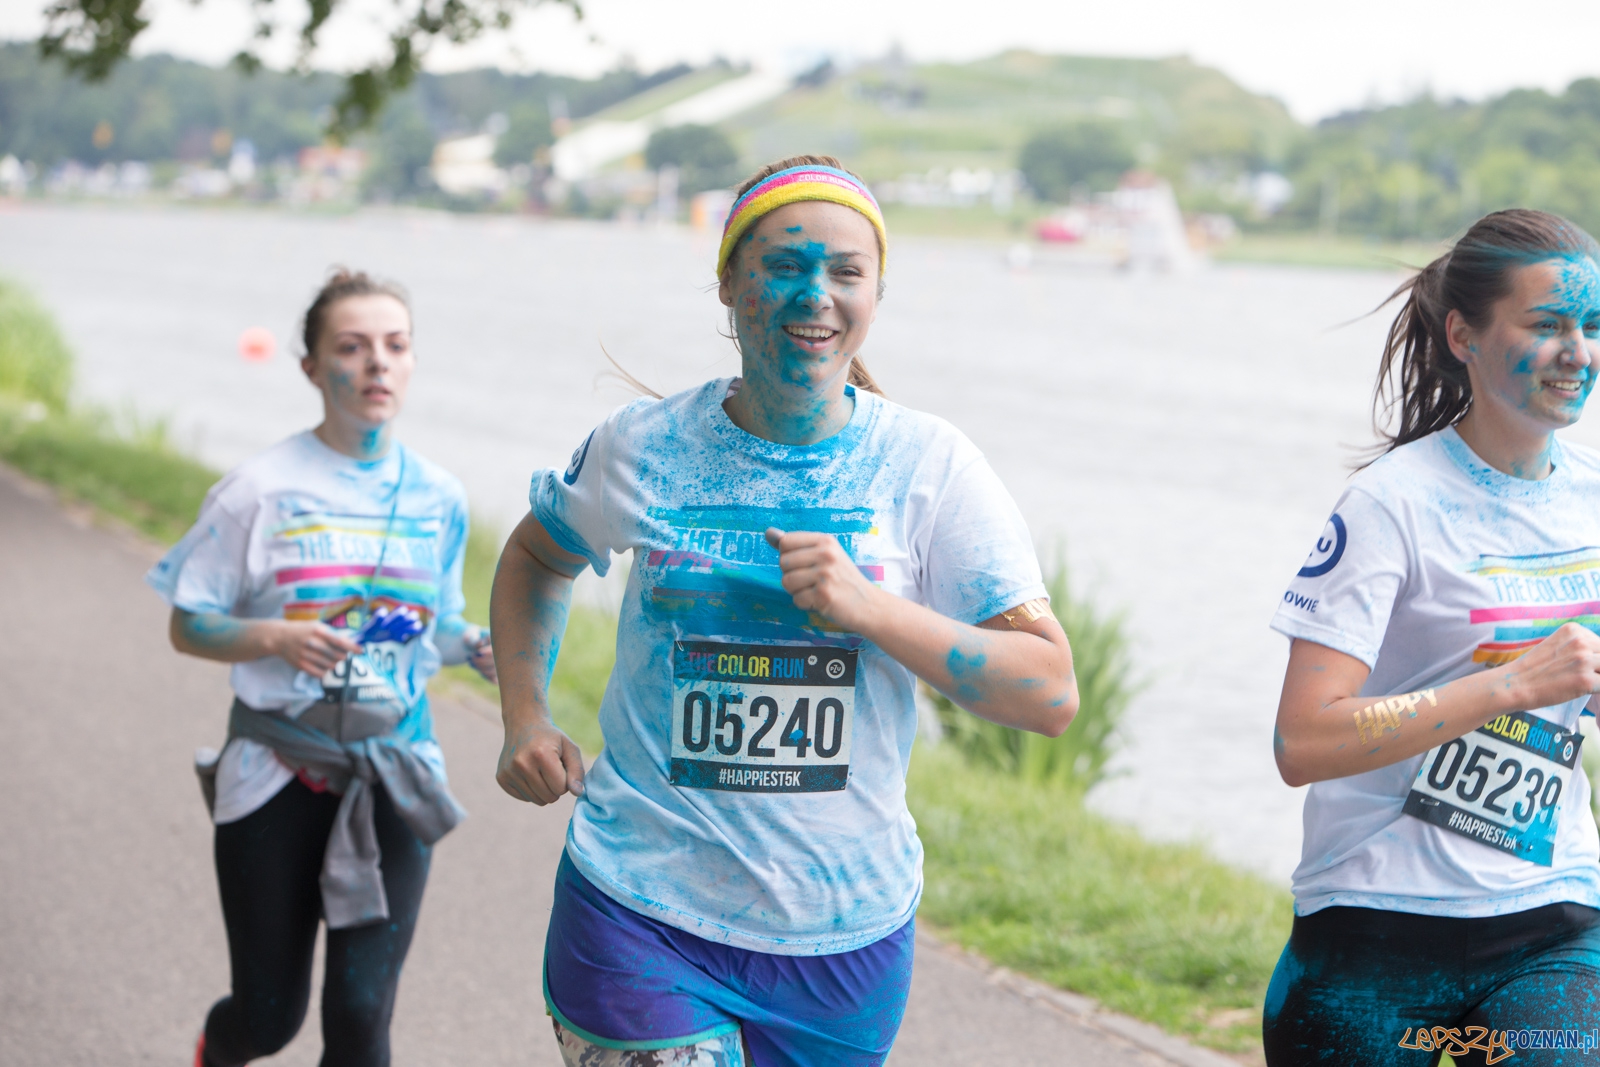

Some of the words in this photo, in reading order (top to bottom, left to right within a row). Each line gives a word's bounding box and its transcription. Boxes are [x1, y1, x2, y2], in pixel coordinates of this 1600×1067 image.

[799, 173, 828, 182] COLOR
[721, 531, 780, 566] COL
[1488, 576, 1527, 602] THE
[1525, 573, 1593, 602] COLOR
[717, 653, 770, 678] COLOR
[682, 690, 844, 759] 05240
[1353, 688, 1437, 746] HAPPY
[718, 767, 802, 787] #HAPPIEST5K
[1427, 736, 1563, 829] 05239
